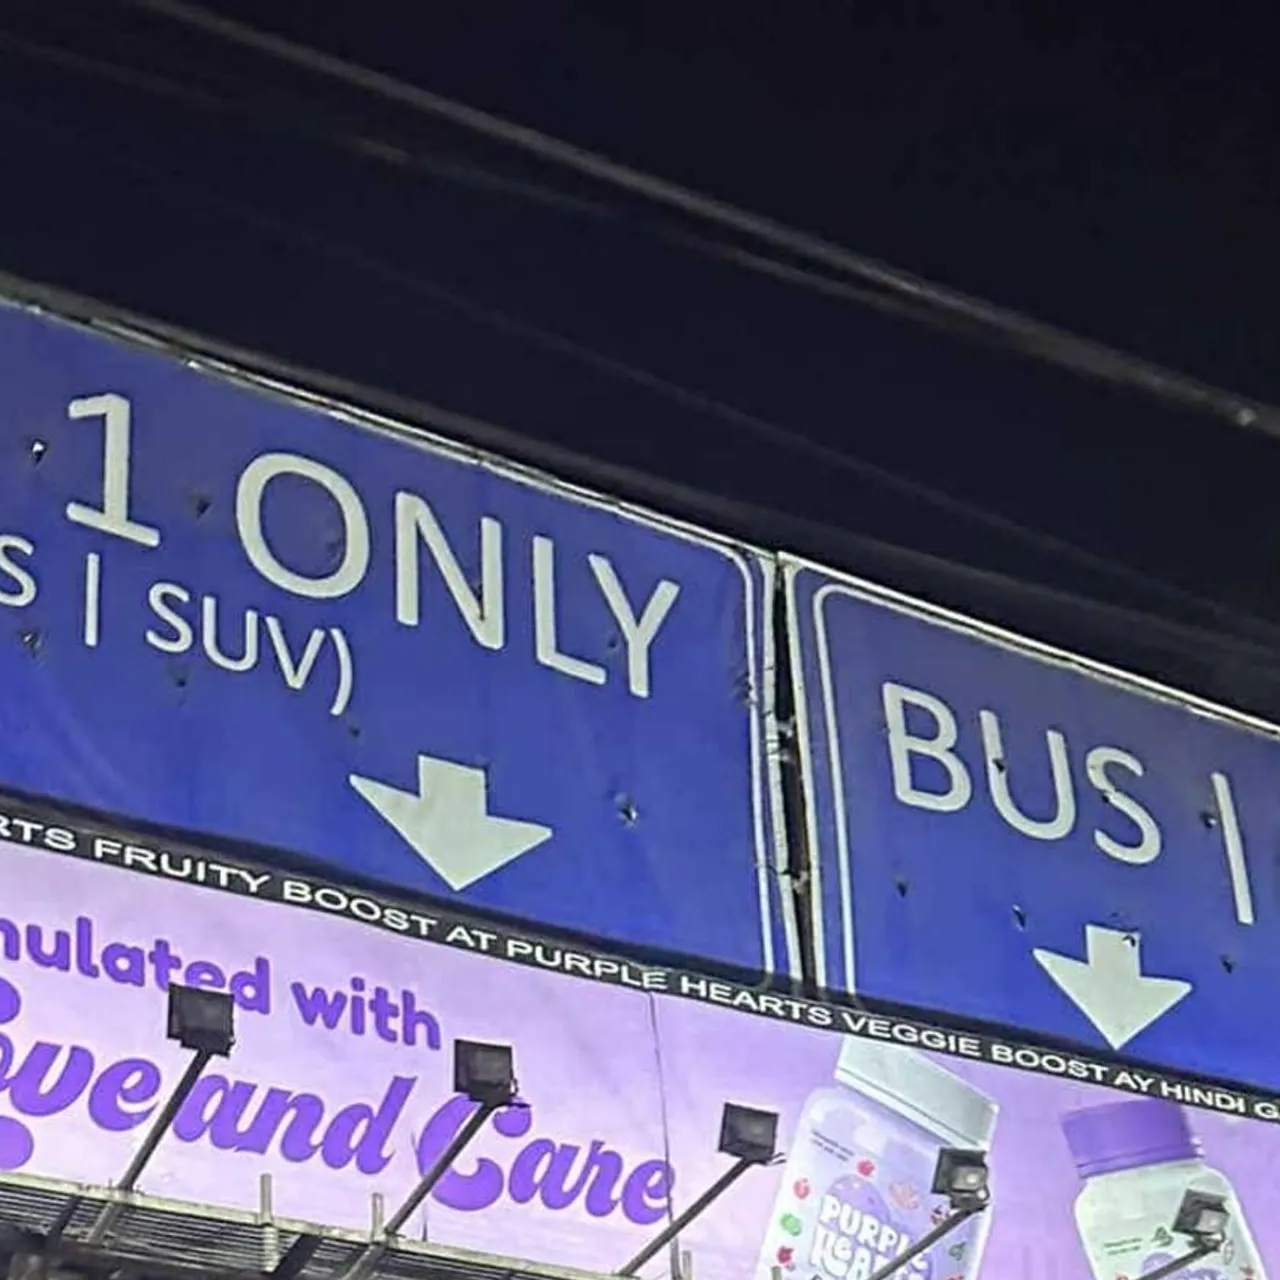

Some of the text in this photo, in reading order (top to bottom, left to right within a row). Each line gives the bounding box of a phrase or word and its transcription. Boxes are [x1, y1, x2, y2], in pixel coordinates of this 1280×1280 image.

[67, 393, 159, 547] 1
[236, 452, 680, 698] ONLY
[146, 582, 353, 715] SUV)
[883, 682, 1162, 865] BUS
[93, 839, 271, 895] FRUITY
[282, 880, 437, 935] BOOST
[445, 925, 497, 952] AT
[506, 940, 668, 990] PURPLE
[680, 976, 834, 1026] HEARTS
[840, 1012, 982, 1058] VEGGIE
[991, 1043, 1108, 1081] BOOST
[1114, 1071, 1153, 1094] AY
[1160, 1080, 1247, 1113] HINDI
[290, 976, 441, 1050] with
[170, 1075, 417, 1175] and
[420, 1093, 676, 1226] Care
